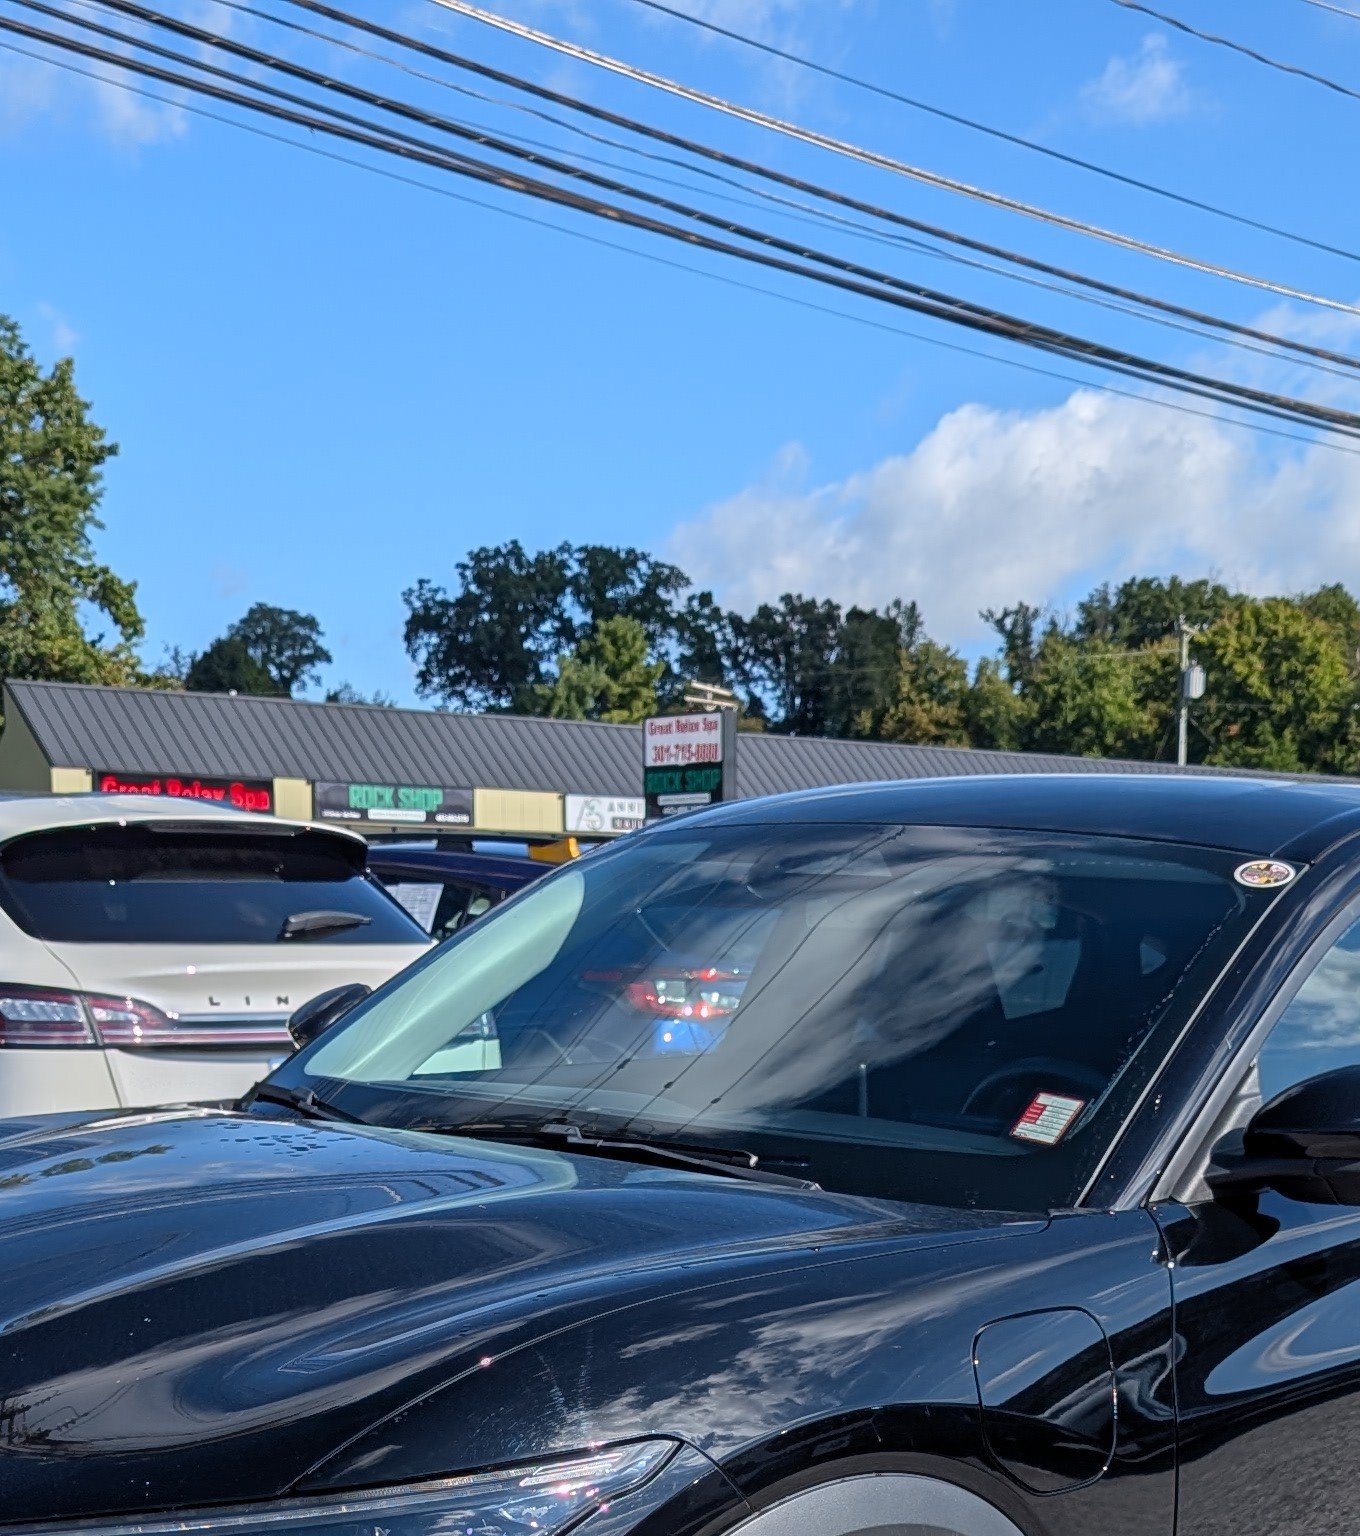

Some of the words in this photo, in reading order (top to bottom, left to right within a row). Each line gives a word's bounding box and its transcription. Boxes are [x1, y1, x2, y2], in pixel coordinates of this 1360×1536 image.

[702, 717, 719, 734] Spa
[349, 784, 394, 808] ROCK
[398, 786, 443, 812] SHOP
